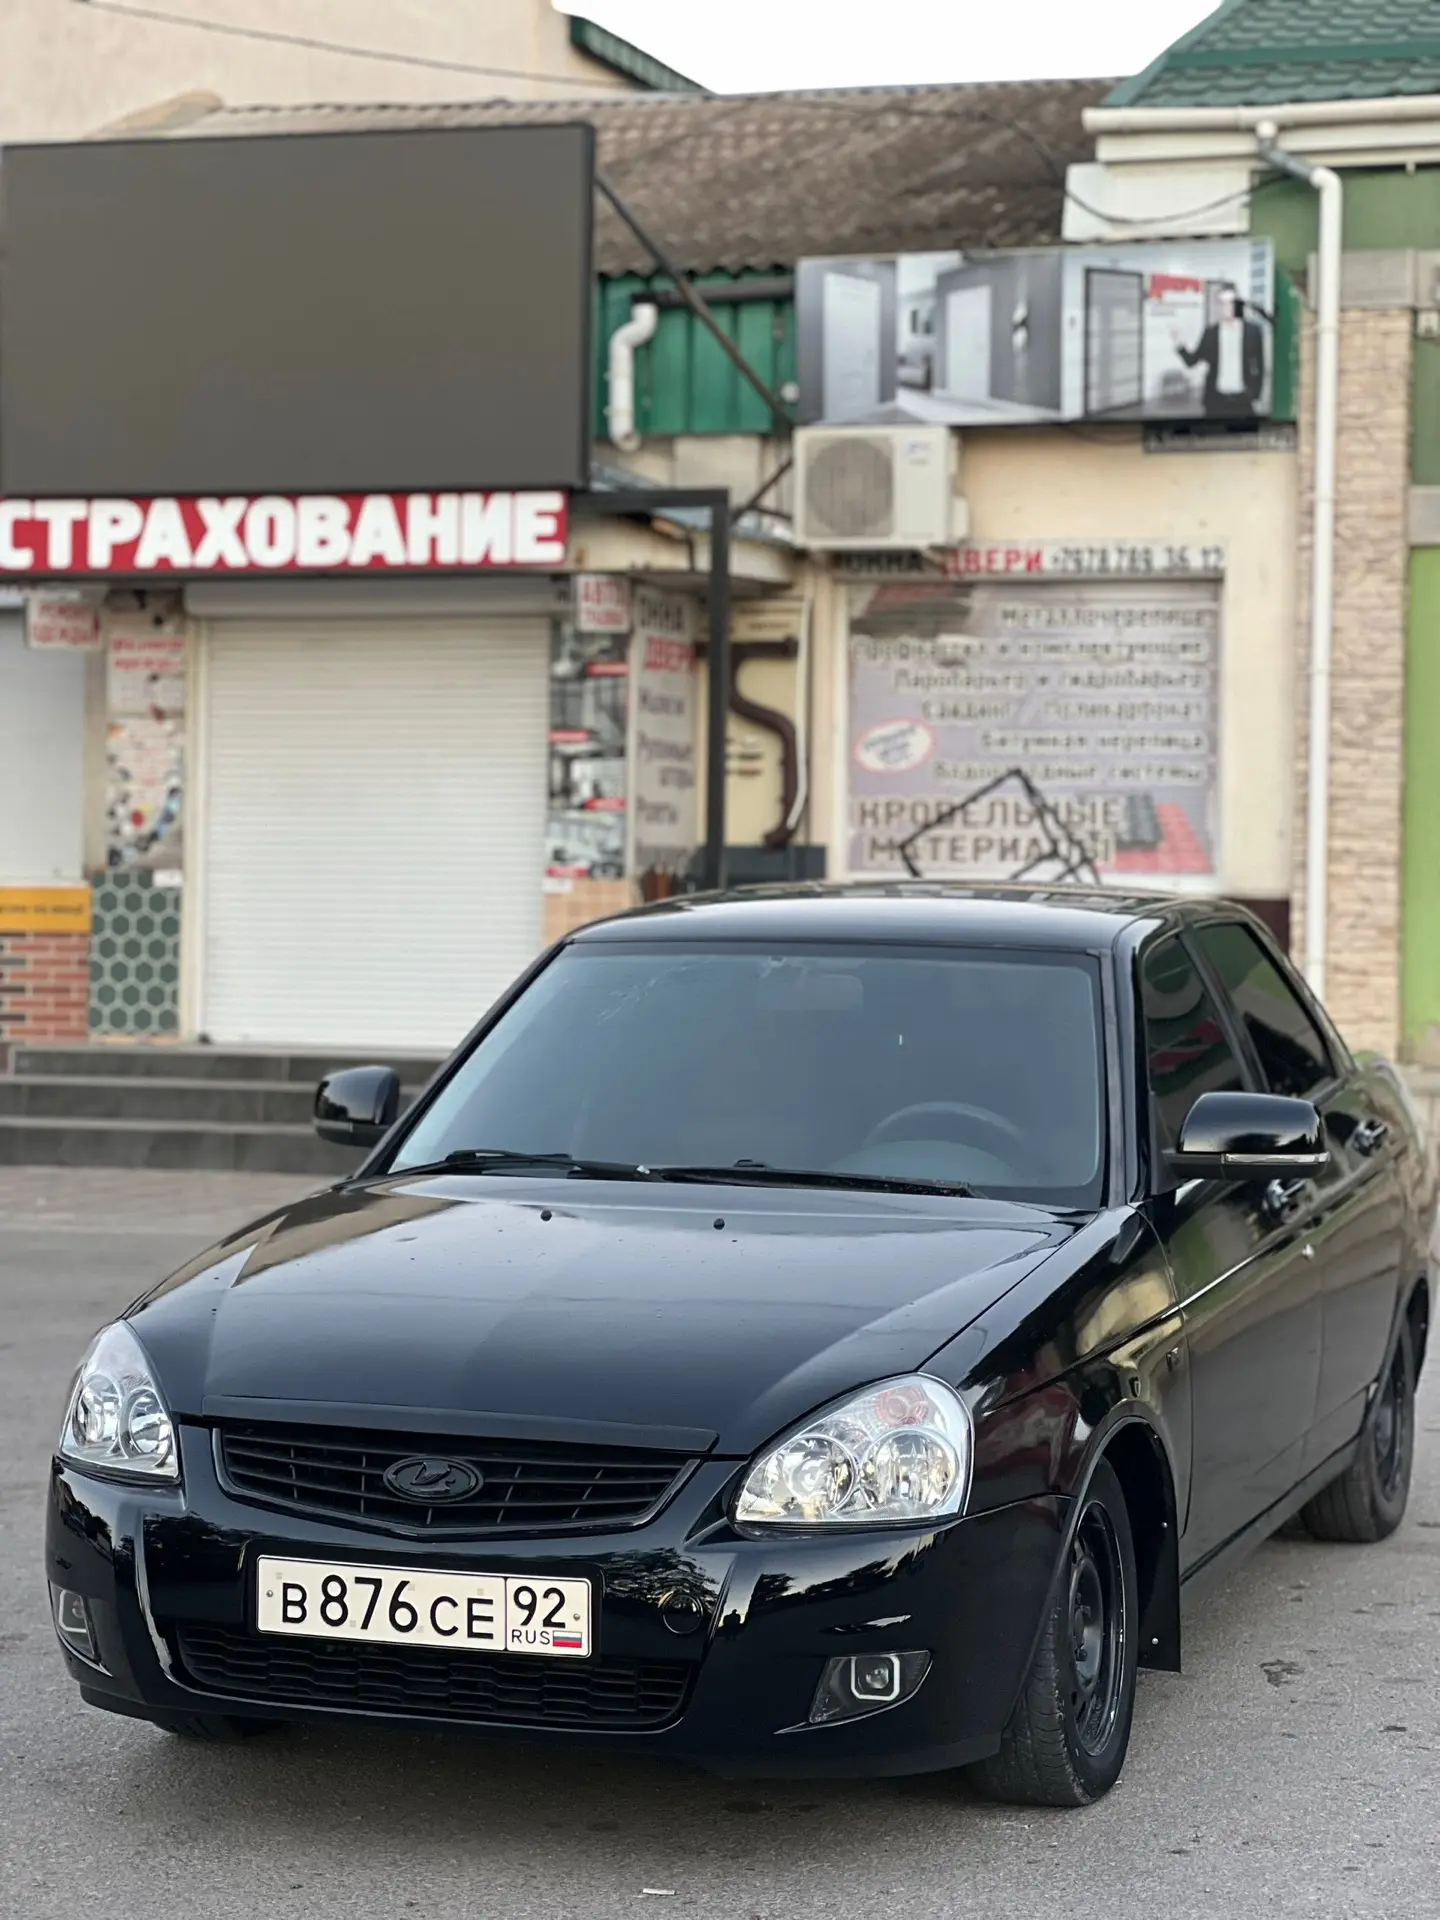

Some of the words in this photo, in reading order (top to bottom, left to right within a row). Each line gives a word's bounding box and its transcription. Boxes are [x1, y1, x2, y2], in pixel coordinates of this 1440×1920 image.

[0, 491, 565, 568] СТРАХОВАНИЕ
[942, 548, 1043, 577] ДВЕРИ
[282, 1574, 494, 1640] В876СЕ
[513, 1586, 566, 1629] 92
[511, 1629, 550, 1646] RUS
